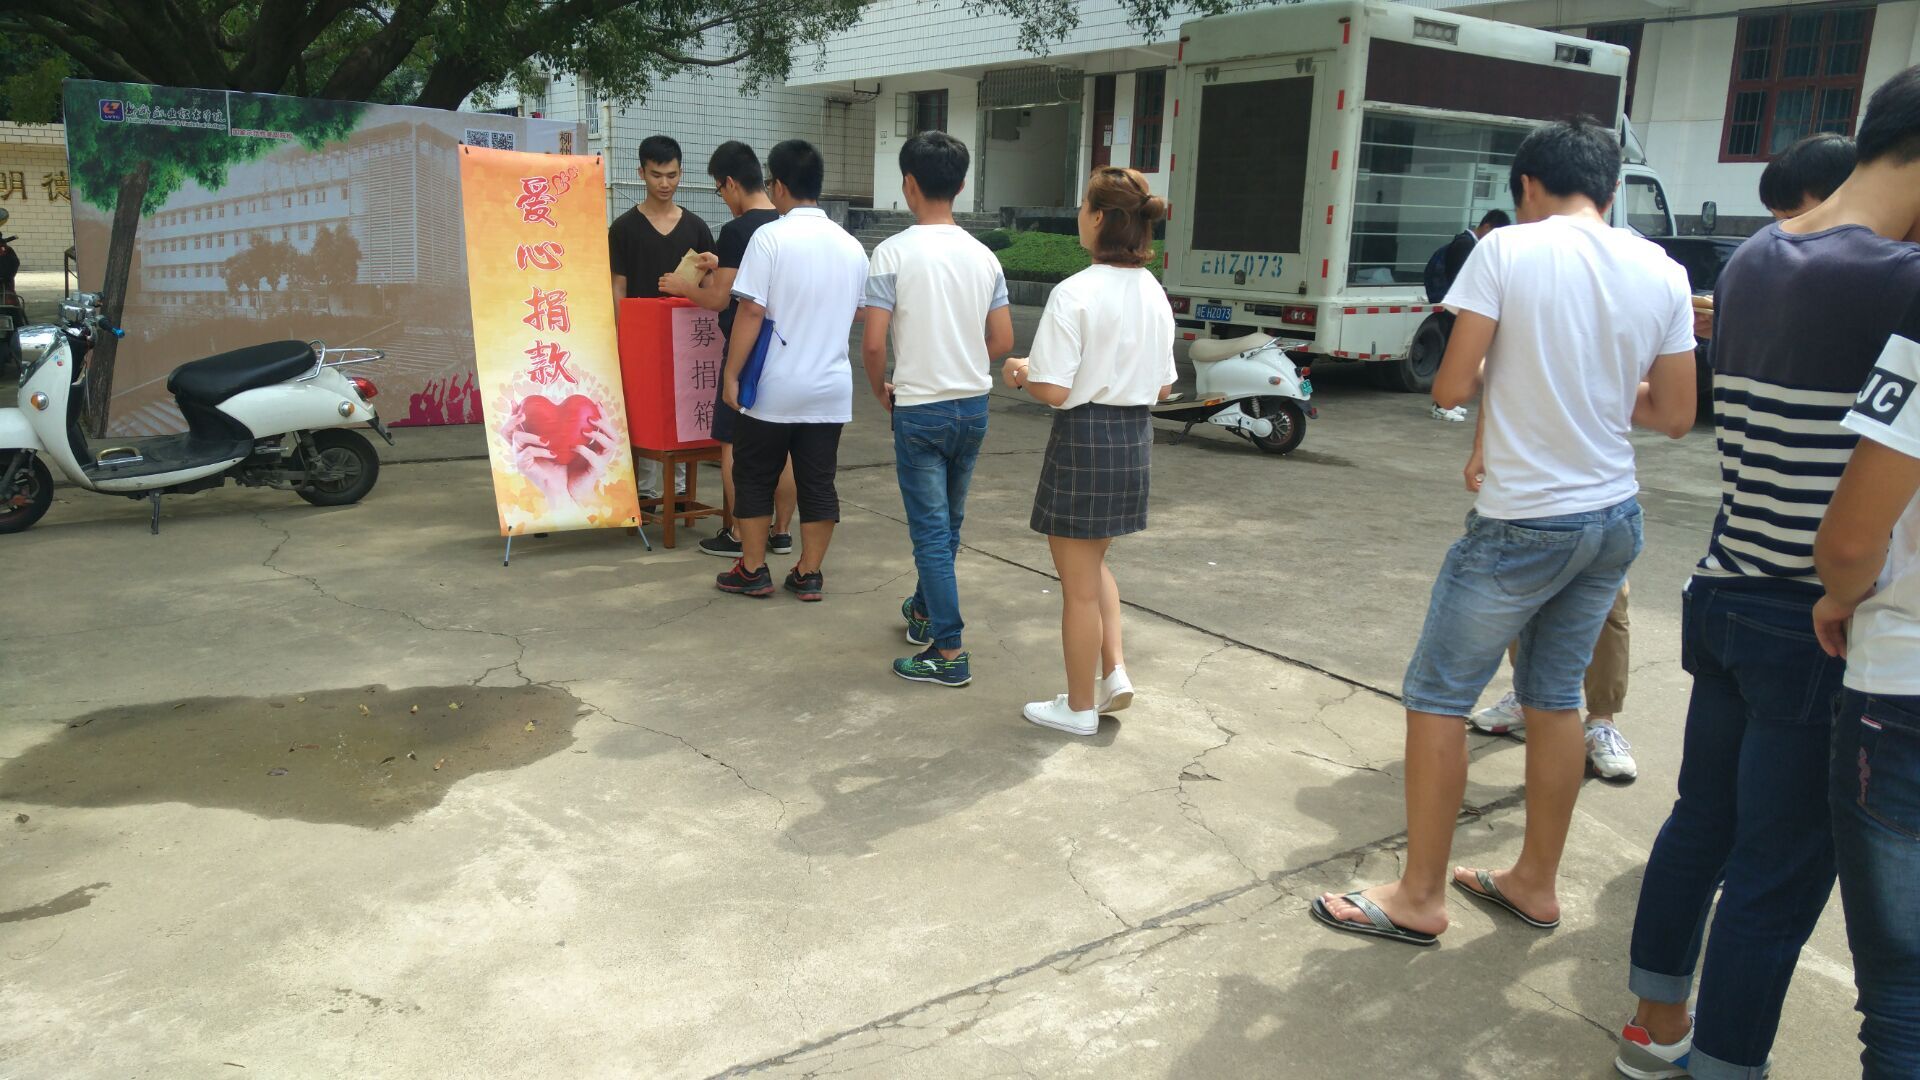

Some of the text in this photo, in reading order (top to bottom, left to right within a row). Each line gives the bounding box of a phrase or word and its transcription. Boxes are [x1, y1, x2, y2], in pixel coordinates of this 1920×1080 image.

[515, 176, 579, 386] 爱心捐款
[689, 316, 716, 431] 募捐箱
